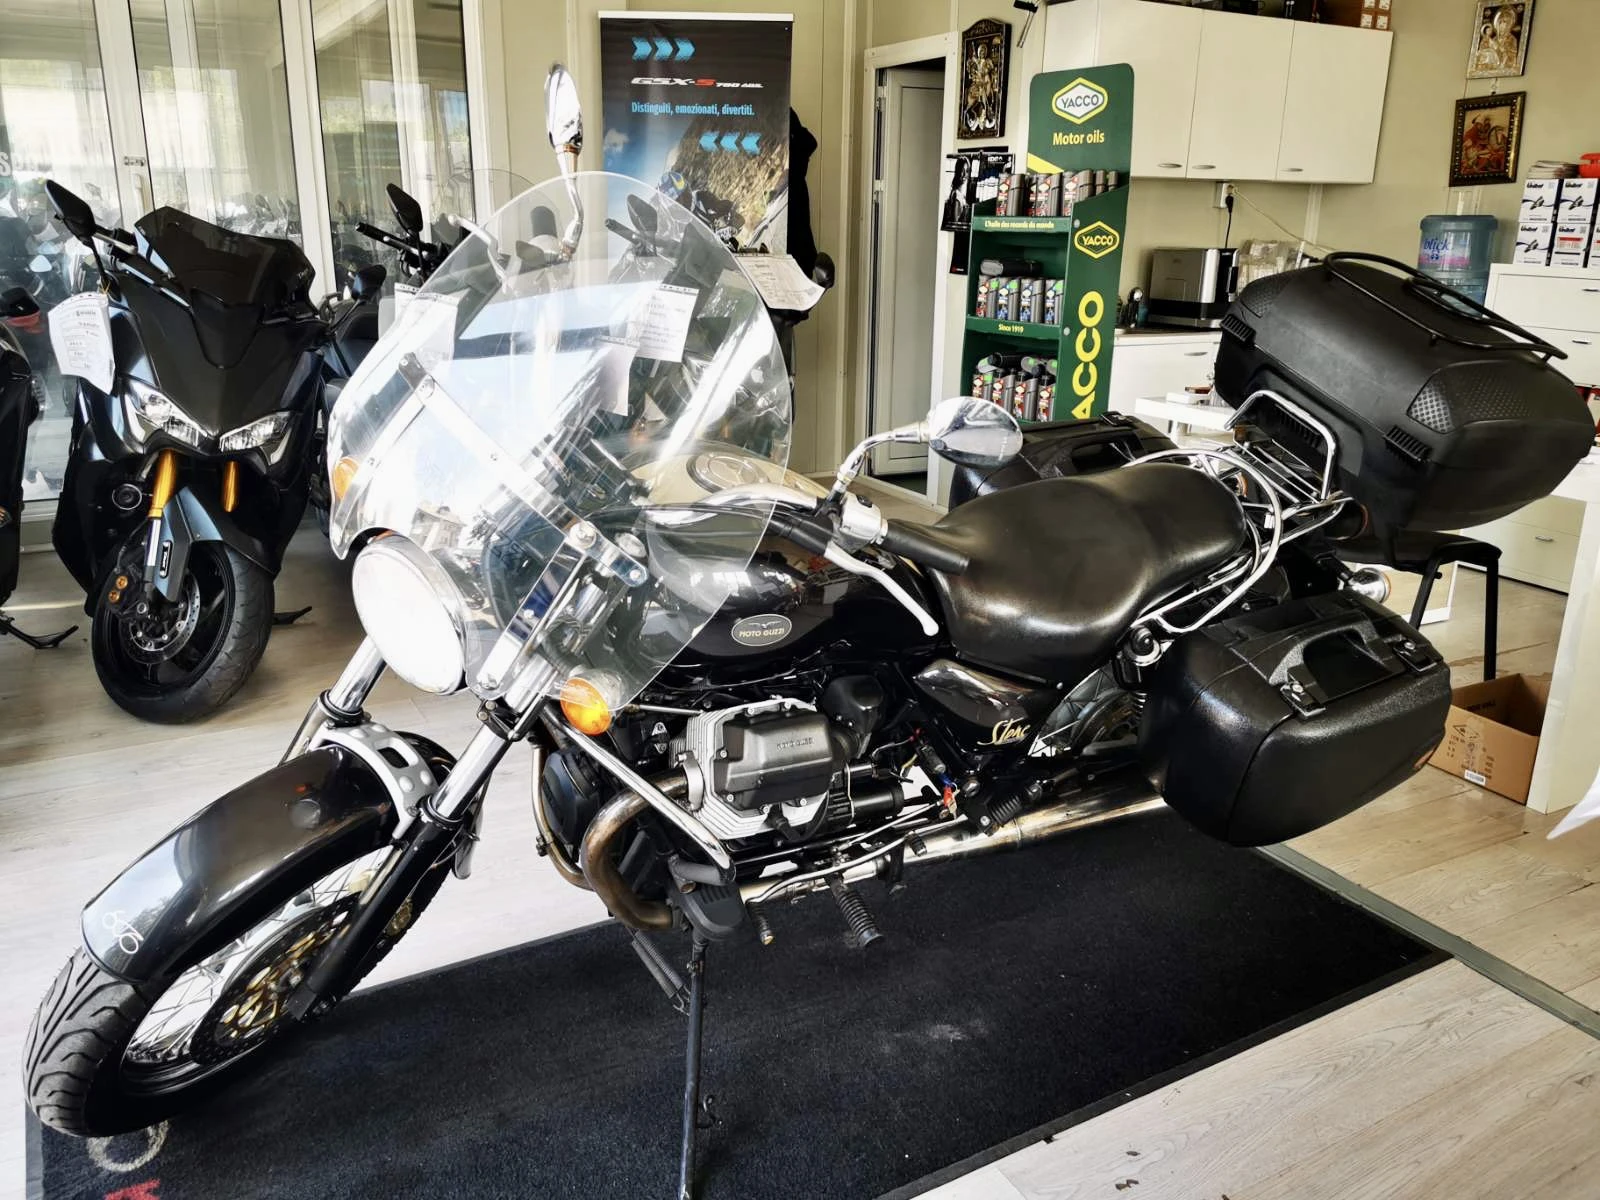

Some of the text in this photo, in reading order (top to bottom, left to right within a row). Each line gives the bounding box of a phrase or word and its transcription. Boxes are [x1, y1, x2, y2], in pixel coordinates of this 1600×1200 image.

[631, 77, 716, 87] GSX-S
[631, 101, 755, 116] Distinguiti, emozionati, divertiti.
[1061, 94, 1099, 109] YACCO
[1053, 129, 1105, 146] Motor oils
[1082, 235, 1114, 247] YACCO
[1071, 290, 1105, 420] ACCO
[739, 627, 785, 638] MOTO GUZZI
